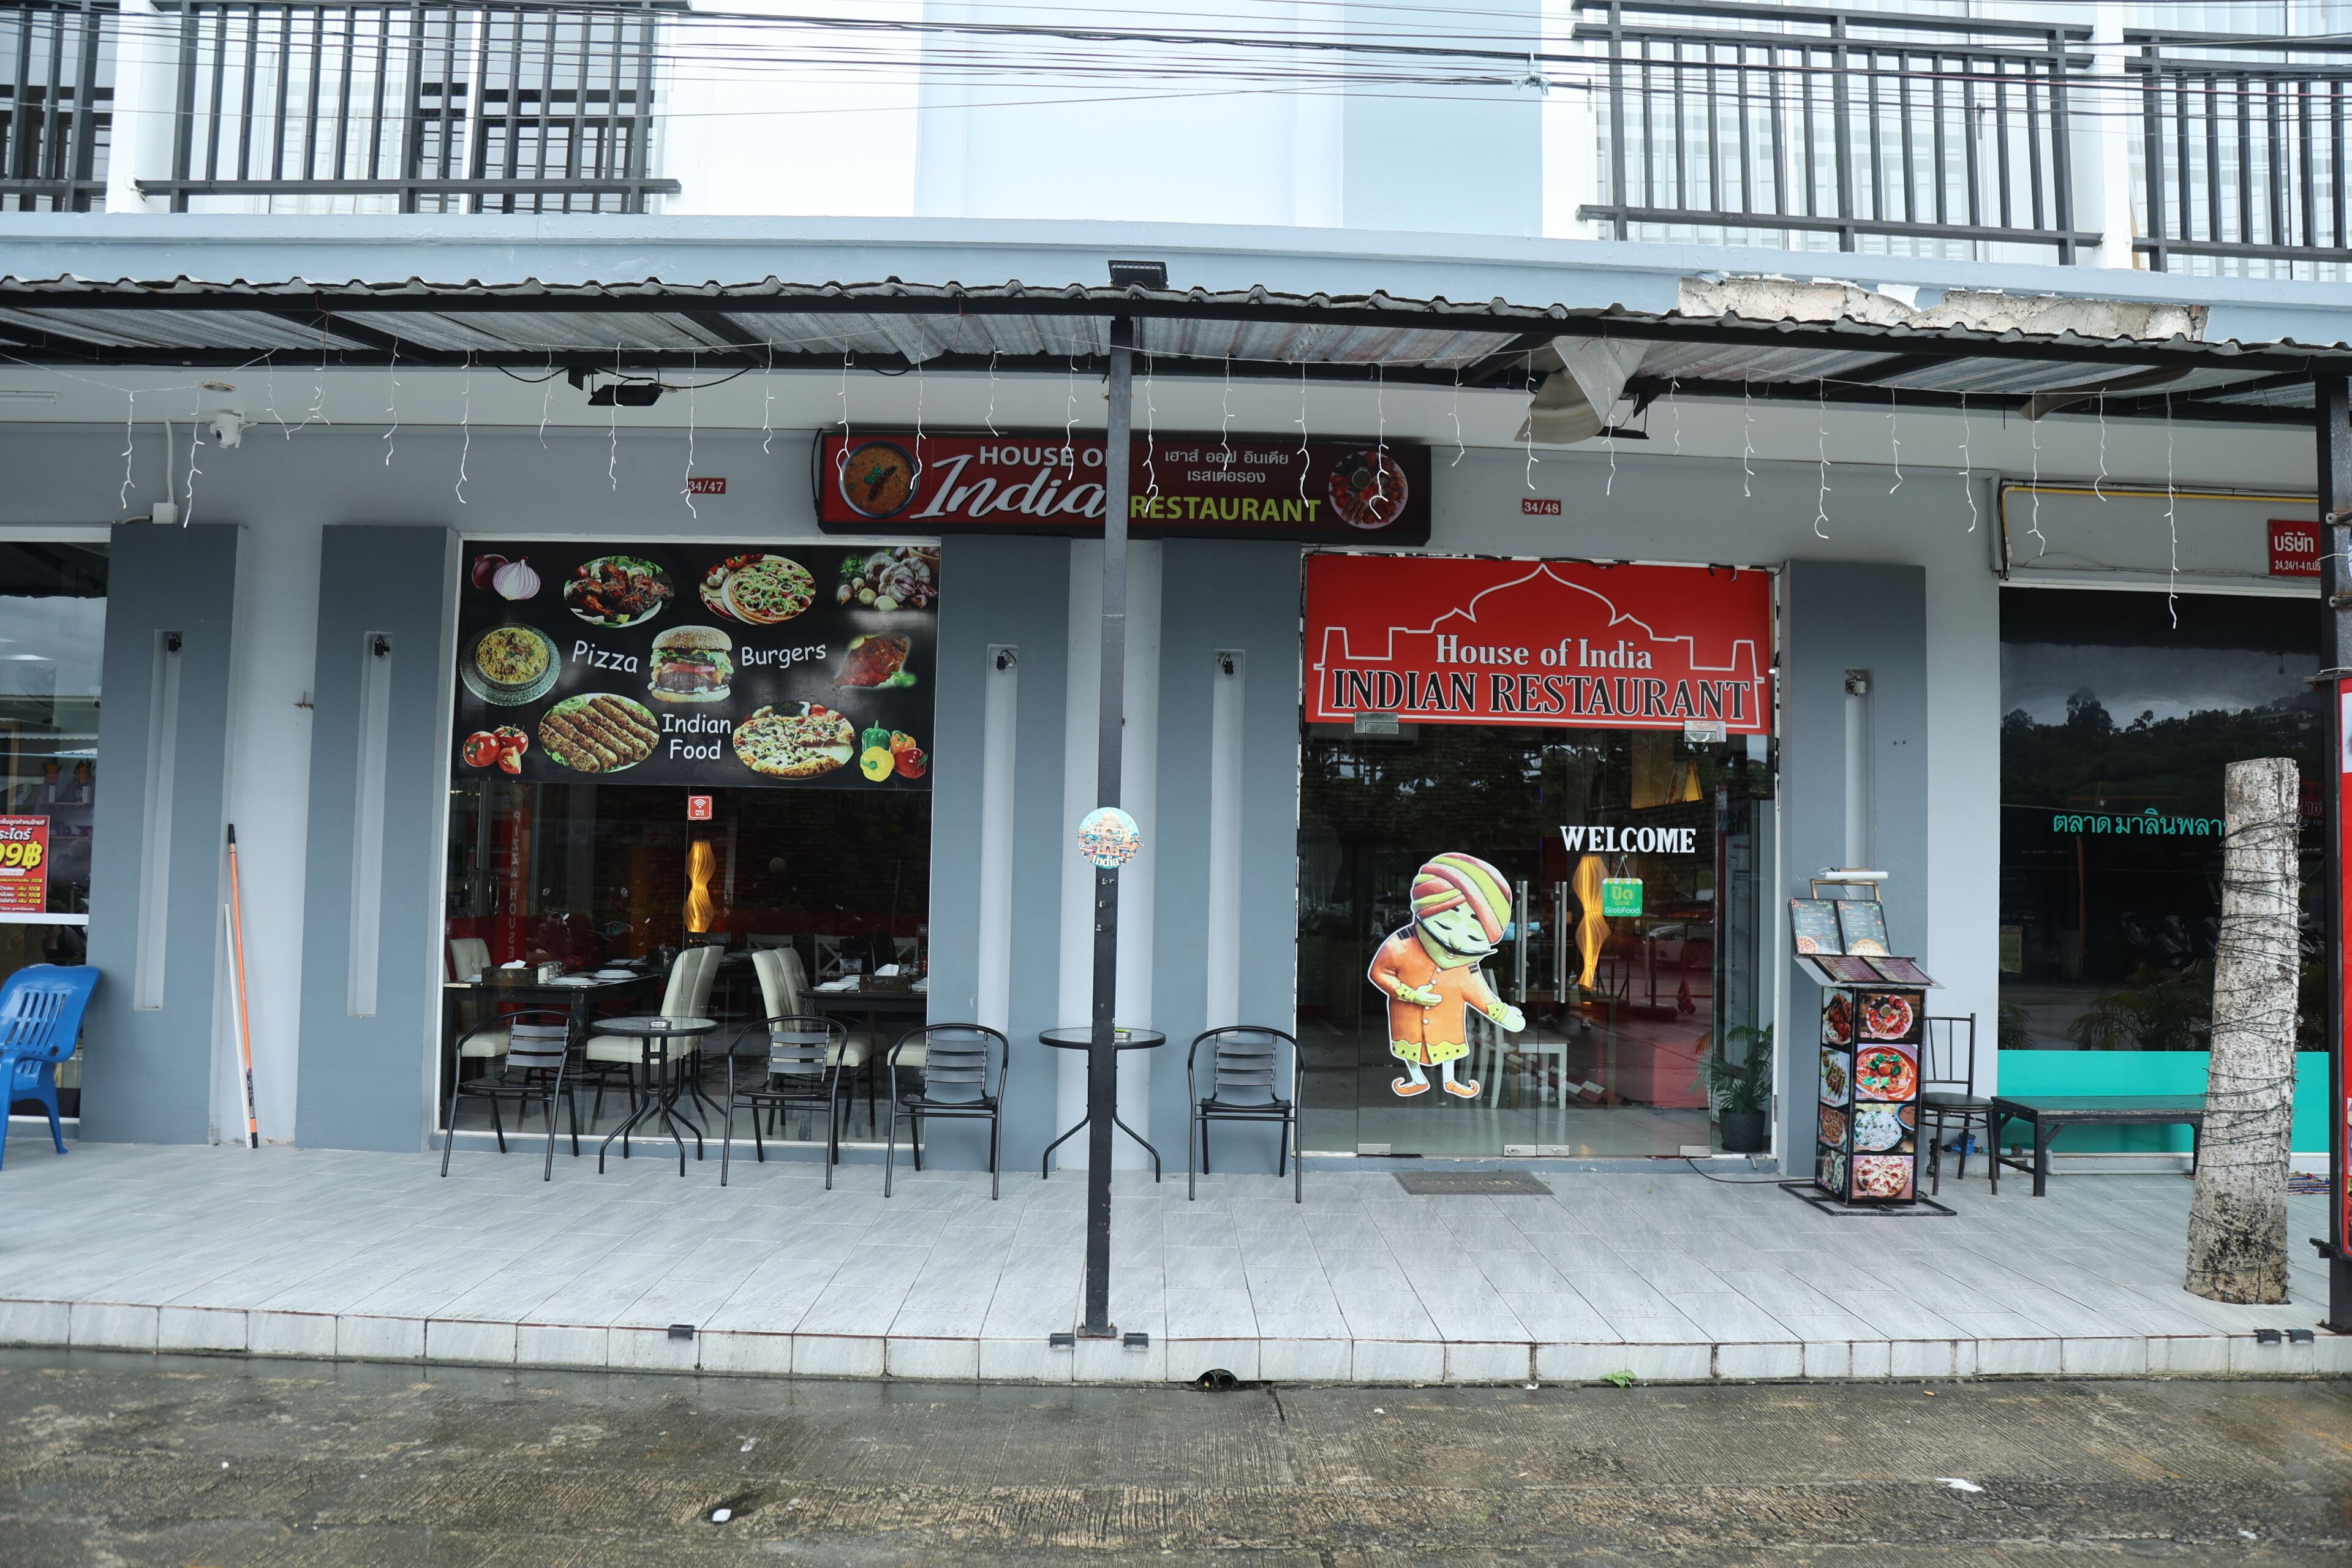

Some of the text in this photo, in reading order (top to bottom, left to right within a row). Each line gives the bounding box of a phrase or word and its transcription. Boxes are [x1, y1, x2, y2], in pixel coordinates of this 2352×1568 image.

[980, 446, 1107, 467] HOUSE O
[1165, 449, 1289, 464] เฮาส์ ออฟ อินเดีย
[688, 480, 723, 492] 34/47
[910, 454, 1106, 518] India
[1188, 470, 1266, 483] เรสเตอรอง
[1131, 496, 1321, 522] RESTAURANT
[1525, 502, 1559, 513] 34/48
[2274, 531, 2314, 552] บริษัท
[2275, 560, 2305, 571] 24,24/1-4
[572, 640, 638, 673] Pizza
[741, 643, 826, 669] Burgers
[1436, 634, 1653, 669] House of India
[1332, 669, 1750, 719] INDIAN RESTAURANT
[662, 714, 731, 734] Indian
[669, 739, 722, 760] Food
[1559, 826, 1696, 853] WELCOME
[1091, 853, 1122, 867] India
[1612, 886, 1633, 900] ปิด
